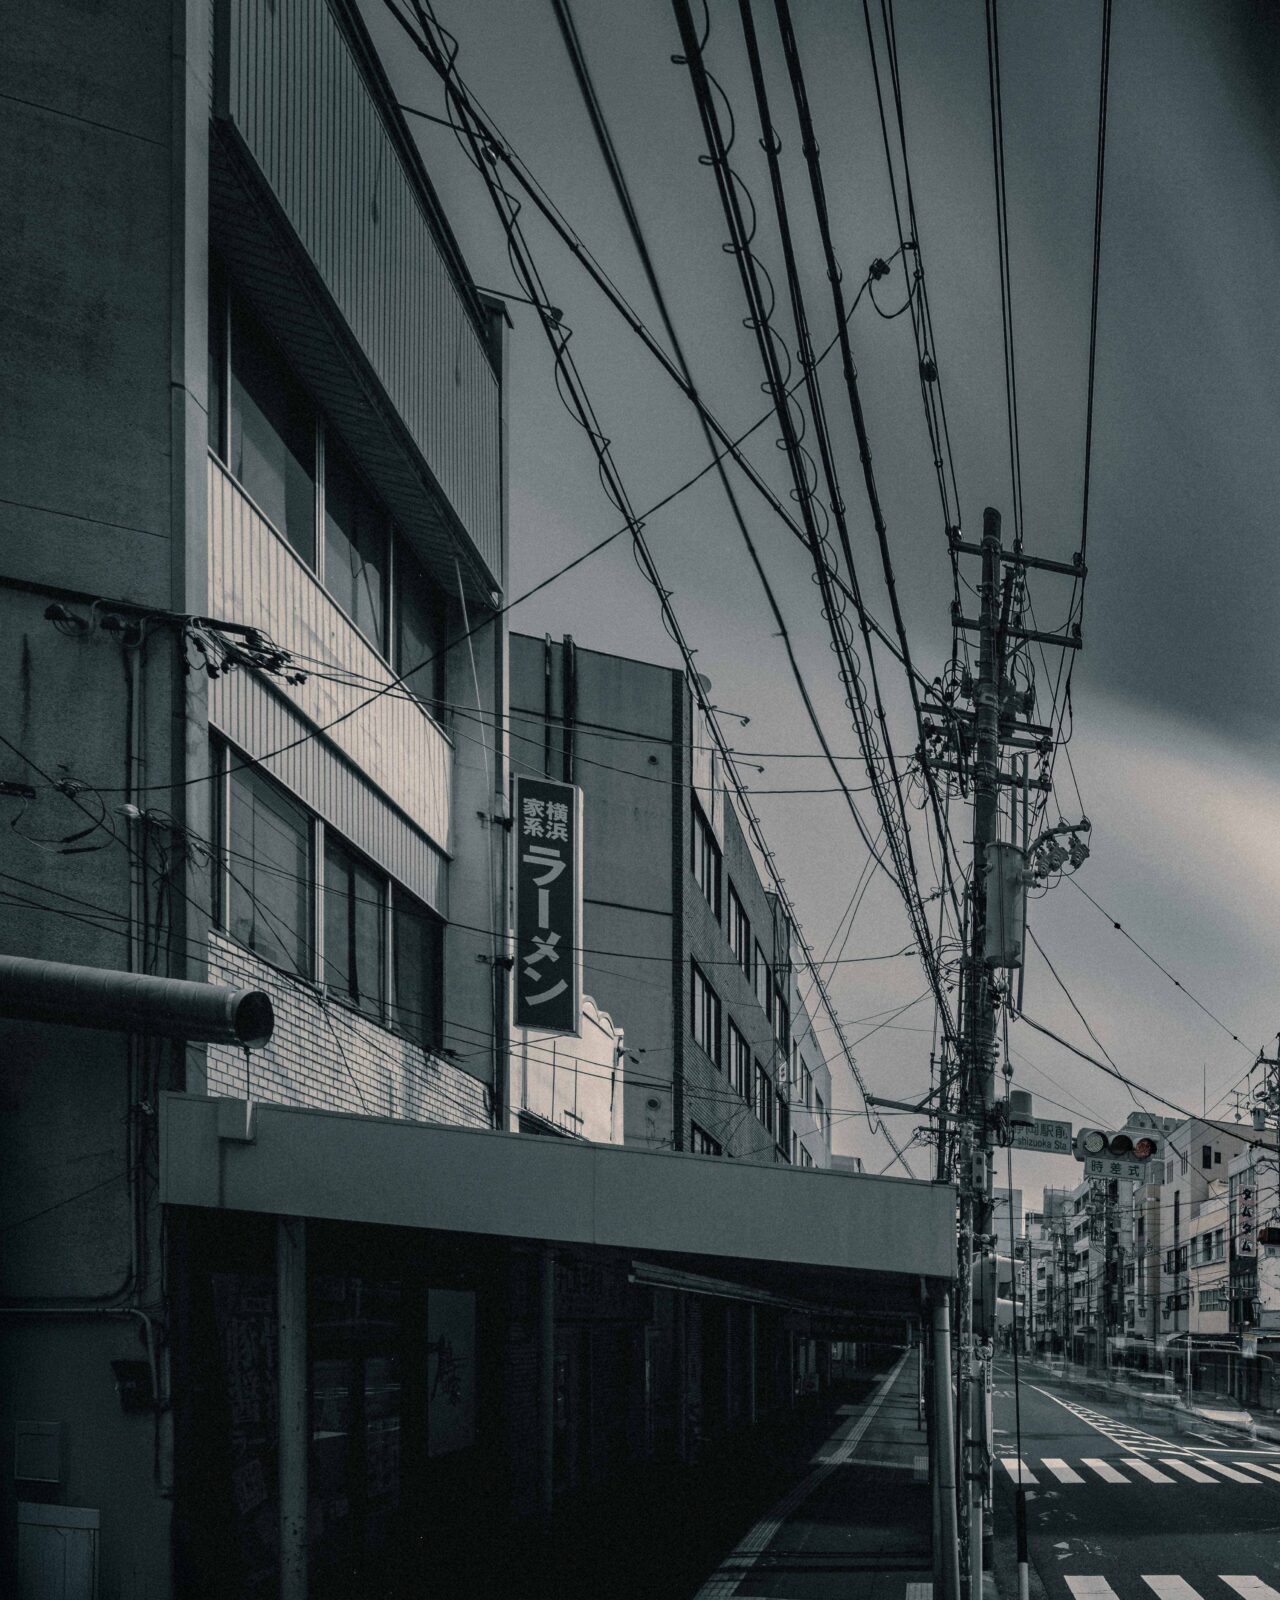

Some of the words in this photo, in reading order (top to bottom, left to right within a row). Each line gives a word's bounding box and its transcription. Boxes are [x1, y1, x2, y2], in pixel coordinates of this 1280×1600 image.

[523, 845, 568, 1006] ラーメン
[1091, 1160, 1140, 1177] 時差式
